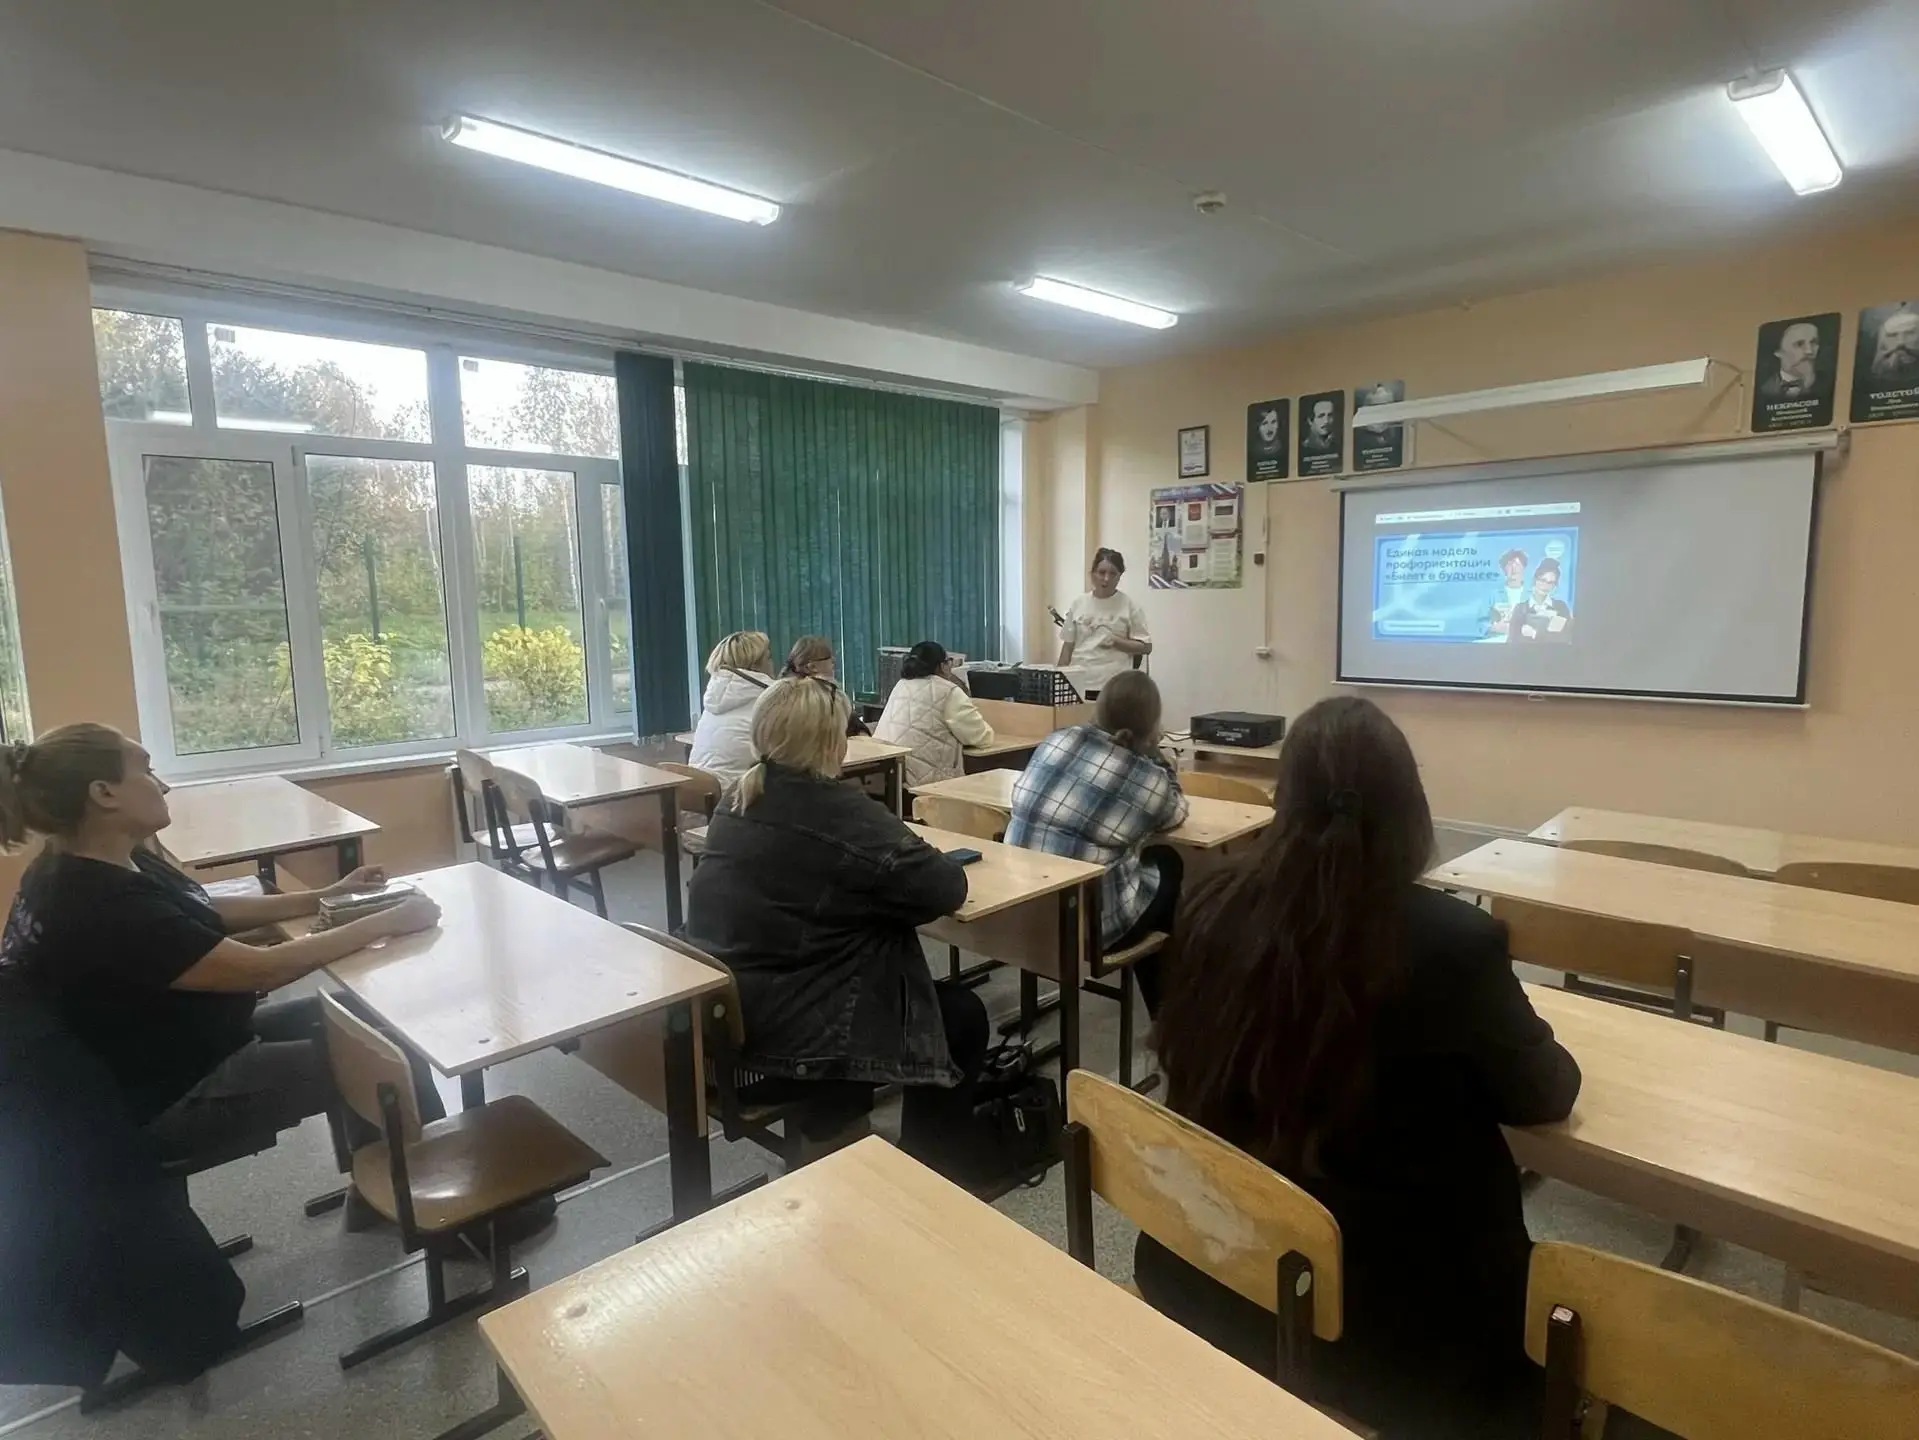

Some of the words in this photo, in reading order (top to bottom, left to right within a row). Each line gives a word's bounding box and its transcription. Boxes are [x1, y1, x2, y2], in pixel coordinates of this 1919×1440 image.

[1386, 548, 1429, 558] Единая
[1432, 547, 1478, 556] модель
[1385, 559, 1491, 570] профориентации
